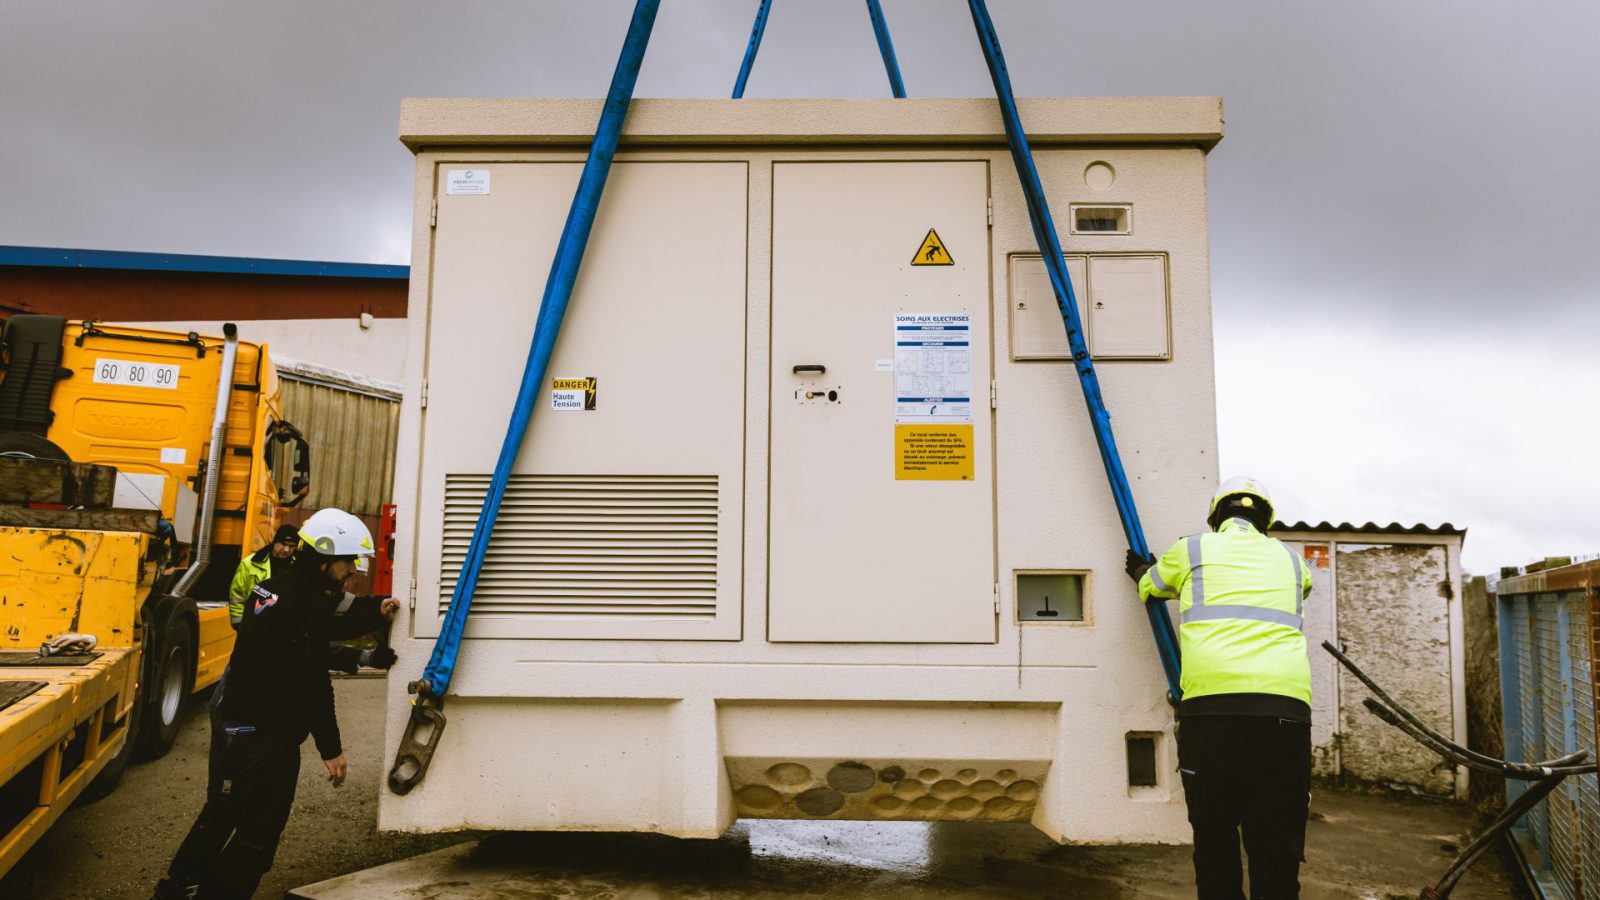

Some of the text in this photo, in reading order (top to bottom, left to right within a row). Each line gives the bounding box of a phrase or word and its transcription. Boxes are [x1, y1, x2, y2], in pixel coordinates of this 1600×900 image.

[101, 364, 172, 384] 60 80 90
[88, 413, 170, 429] VOLVO
